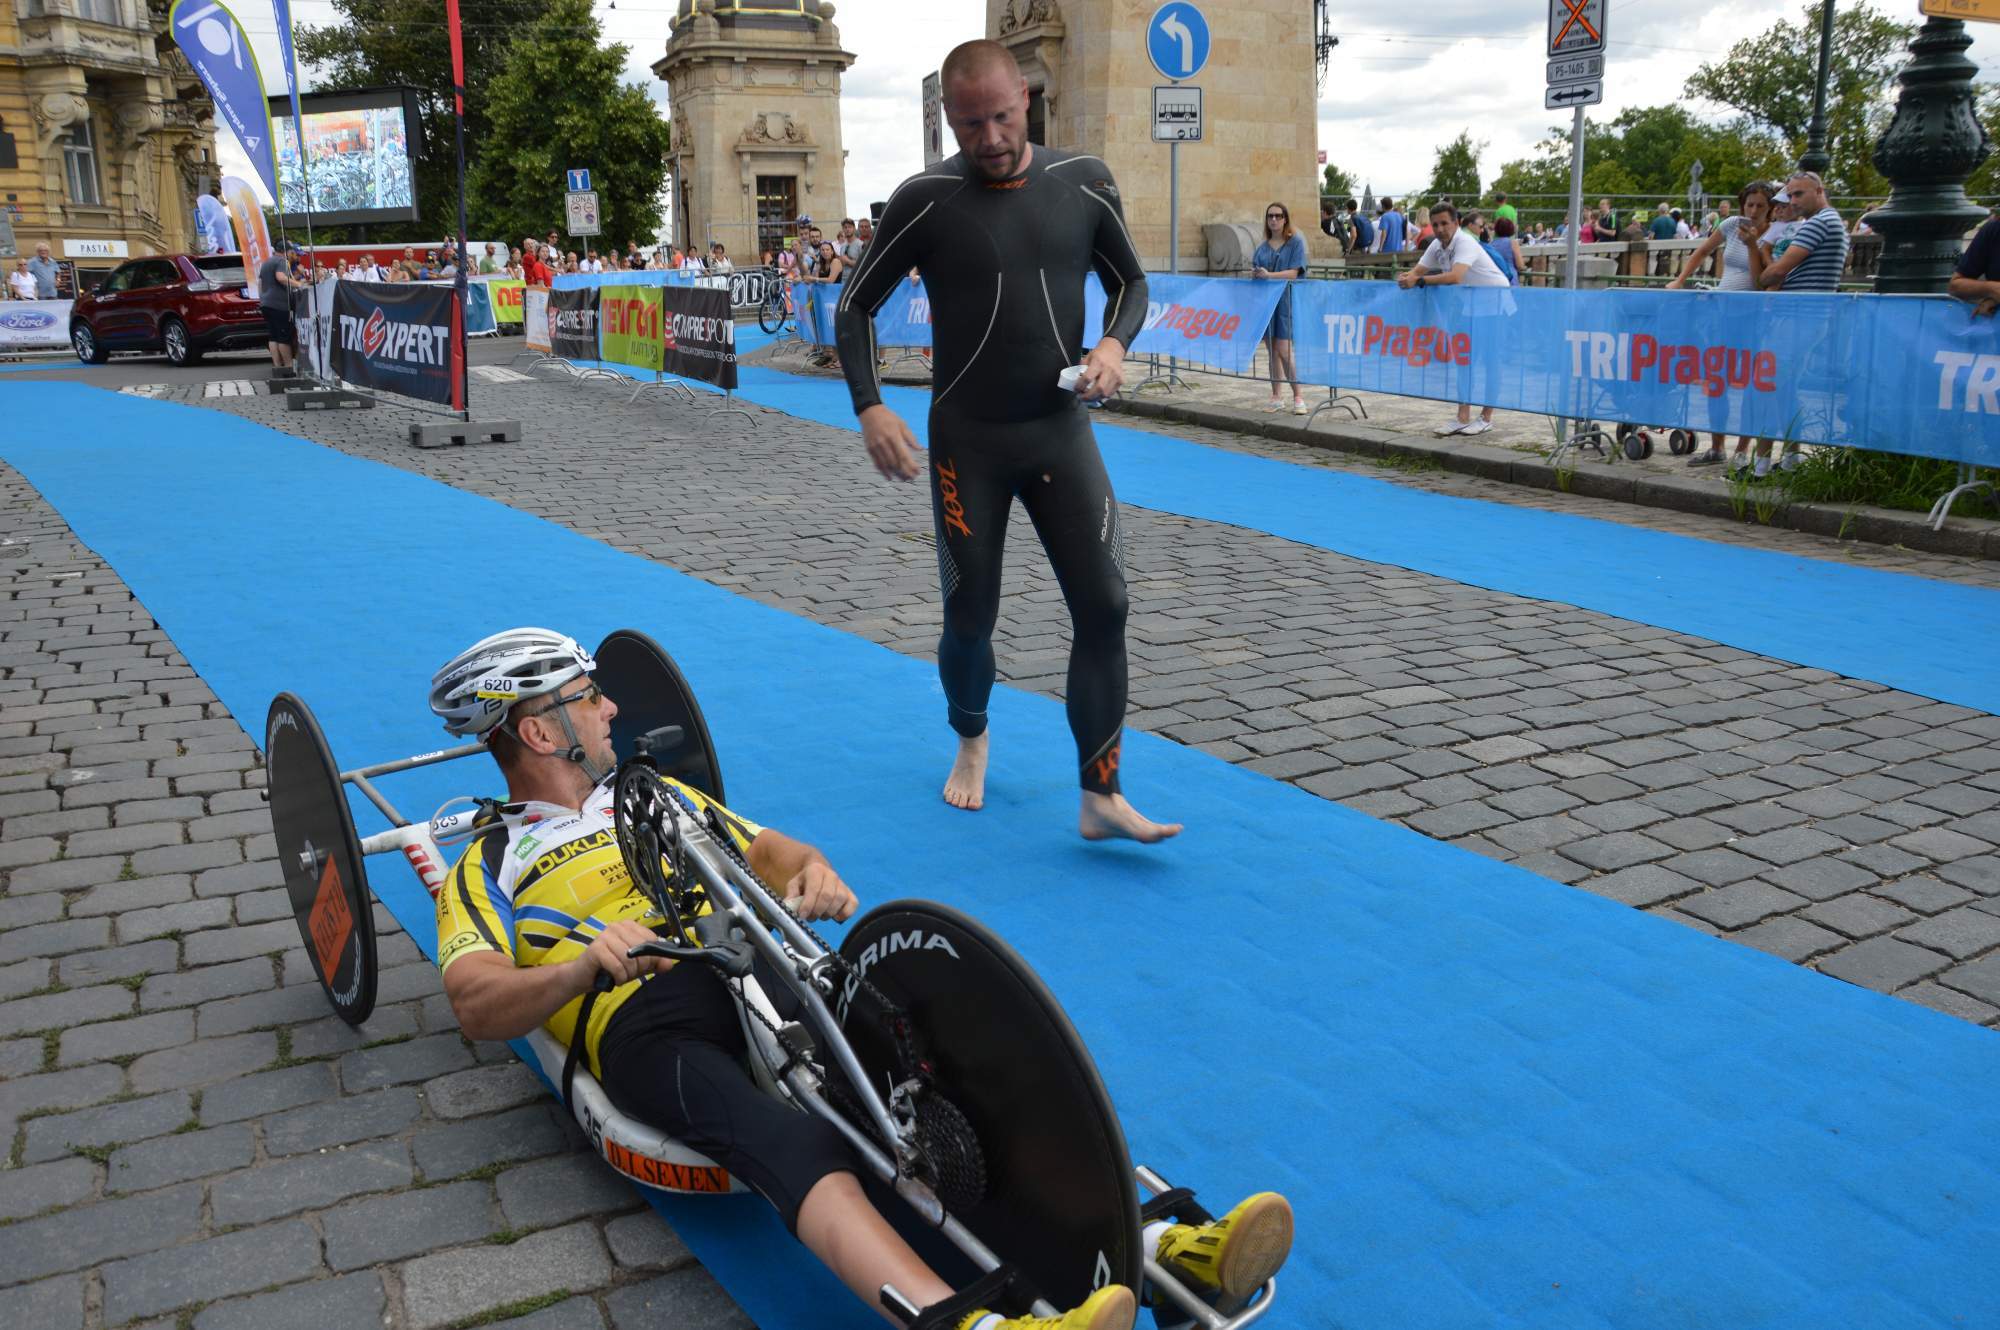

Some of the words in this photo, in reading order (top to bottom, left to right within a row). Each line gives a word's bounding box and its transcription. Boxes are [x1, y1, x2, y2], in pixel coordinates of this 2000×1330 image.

[80, 244, 108, 254] PASTA
[7, 312, 46, 328] Ford
[1143, 301, 1242, 340] RIPrague
[1323, 314, 1472, 367] TRIPrague
[1565, 330, 1777, 398] TRIPrague
[1933, 350, 2000, 416] TR
[484, 679, 512, 692] 620
[536, 831, 614, 875] DUKLA
[599, 861, 626, 877] PHO
